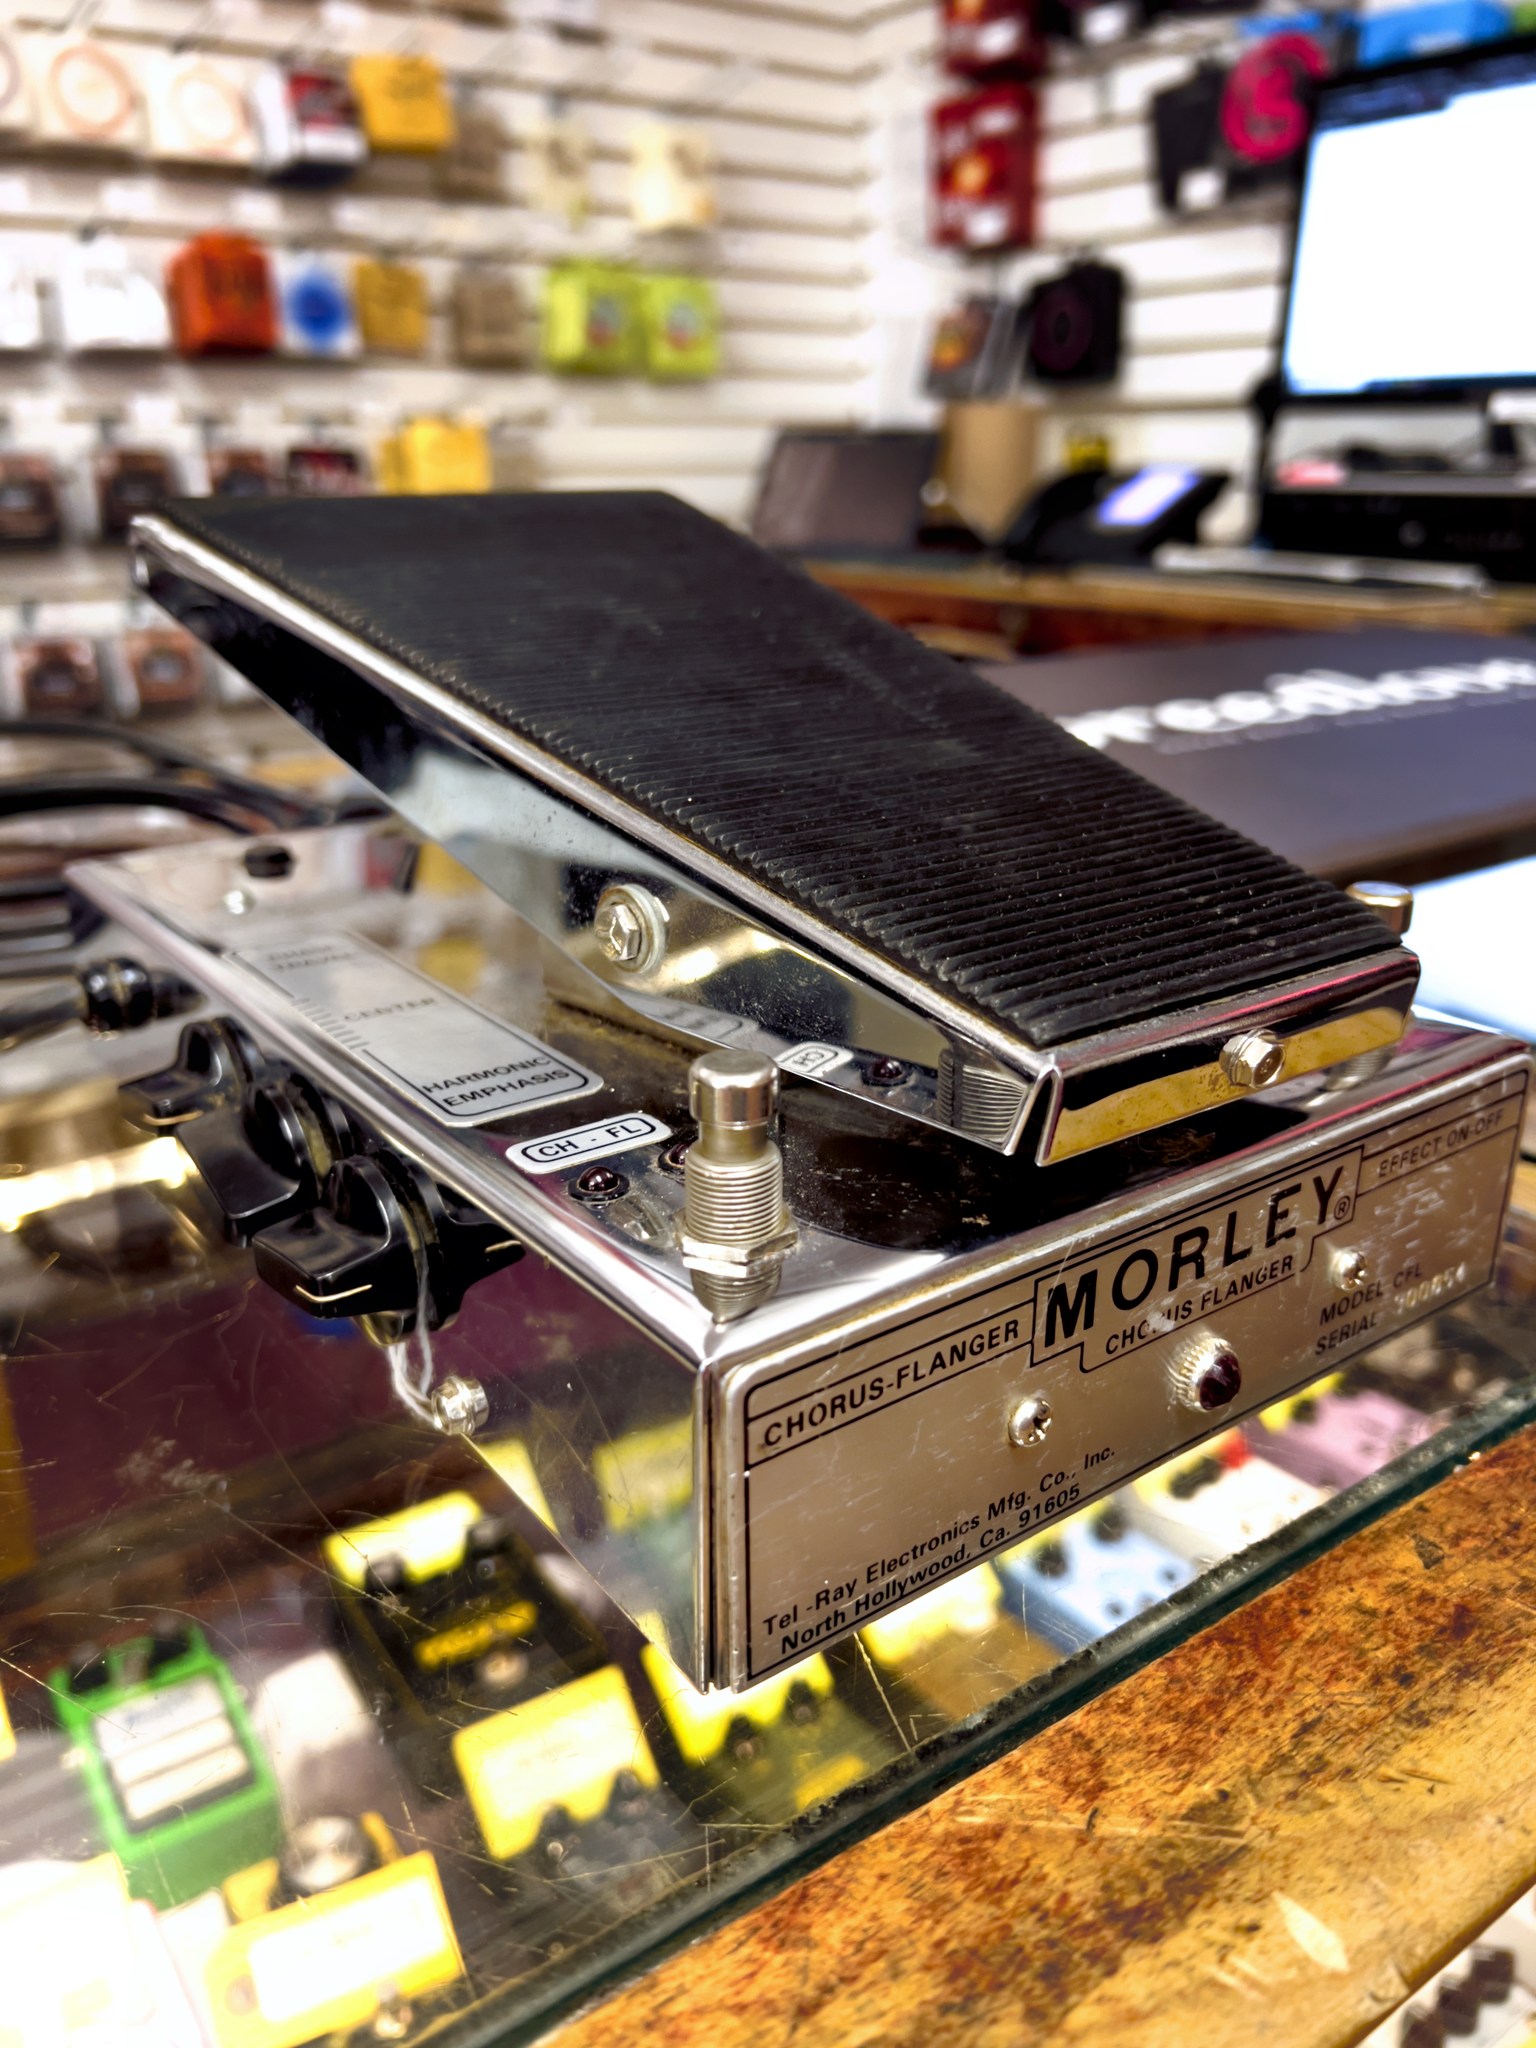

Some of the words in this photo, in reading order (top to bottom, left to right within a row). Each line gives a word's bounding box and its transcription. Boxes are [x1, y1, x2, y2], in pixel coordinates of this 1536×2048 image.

[422, 1056, 551, 1094] HARMONIC
[443, 1068, 571, 1107] EMPHASIS
[538, 1140, 579, 1157] CH
[605, 1123, 642, 1138] FL
[1378, 1136, 1442, 1178] EFFECT
[1446, 1108, 1504, 1147] ON-OFF
[1105, 1300, 1193, 1355] CHOUS
[1201, 1255, 1293, 1311] FLANGER
[1319, 1280, 1384, 1326] MODEL
[1393, 1264, 1423, 1289] CFL
[1314, 1312, 1377, 1355] SERIAL
[764, 1319, 1019, 1446] CHORUS-FLANGER
[763, 1605, 799, 1636] Tel
[866, 1515, 981, 1584] Electronics
[987, 1488, 1032, 1521] Mfg.
[1039, 1470, 1076, 1493] Co.,
[1084, 1446, 1116, 1471] Inc.
[781, 1610, 846, 1655] North
[854, 1545, 972, 1618] Hollywood,
[980, 1527, 1011, 1550] Ca.
[1018, 1482, 1081, 1529] 91605
